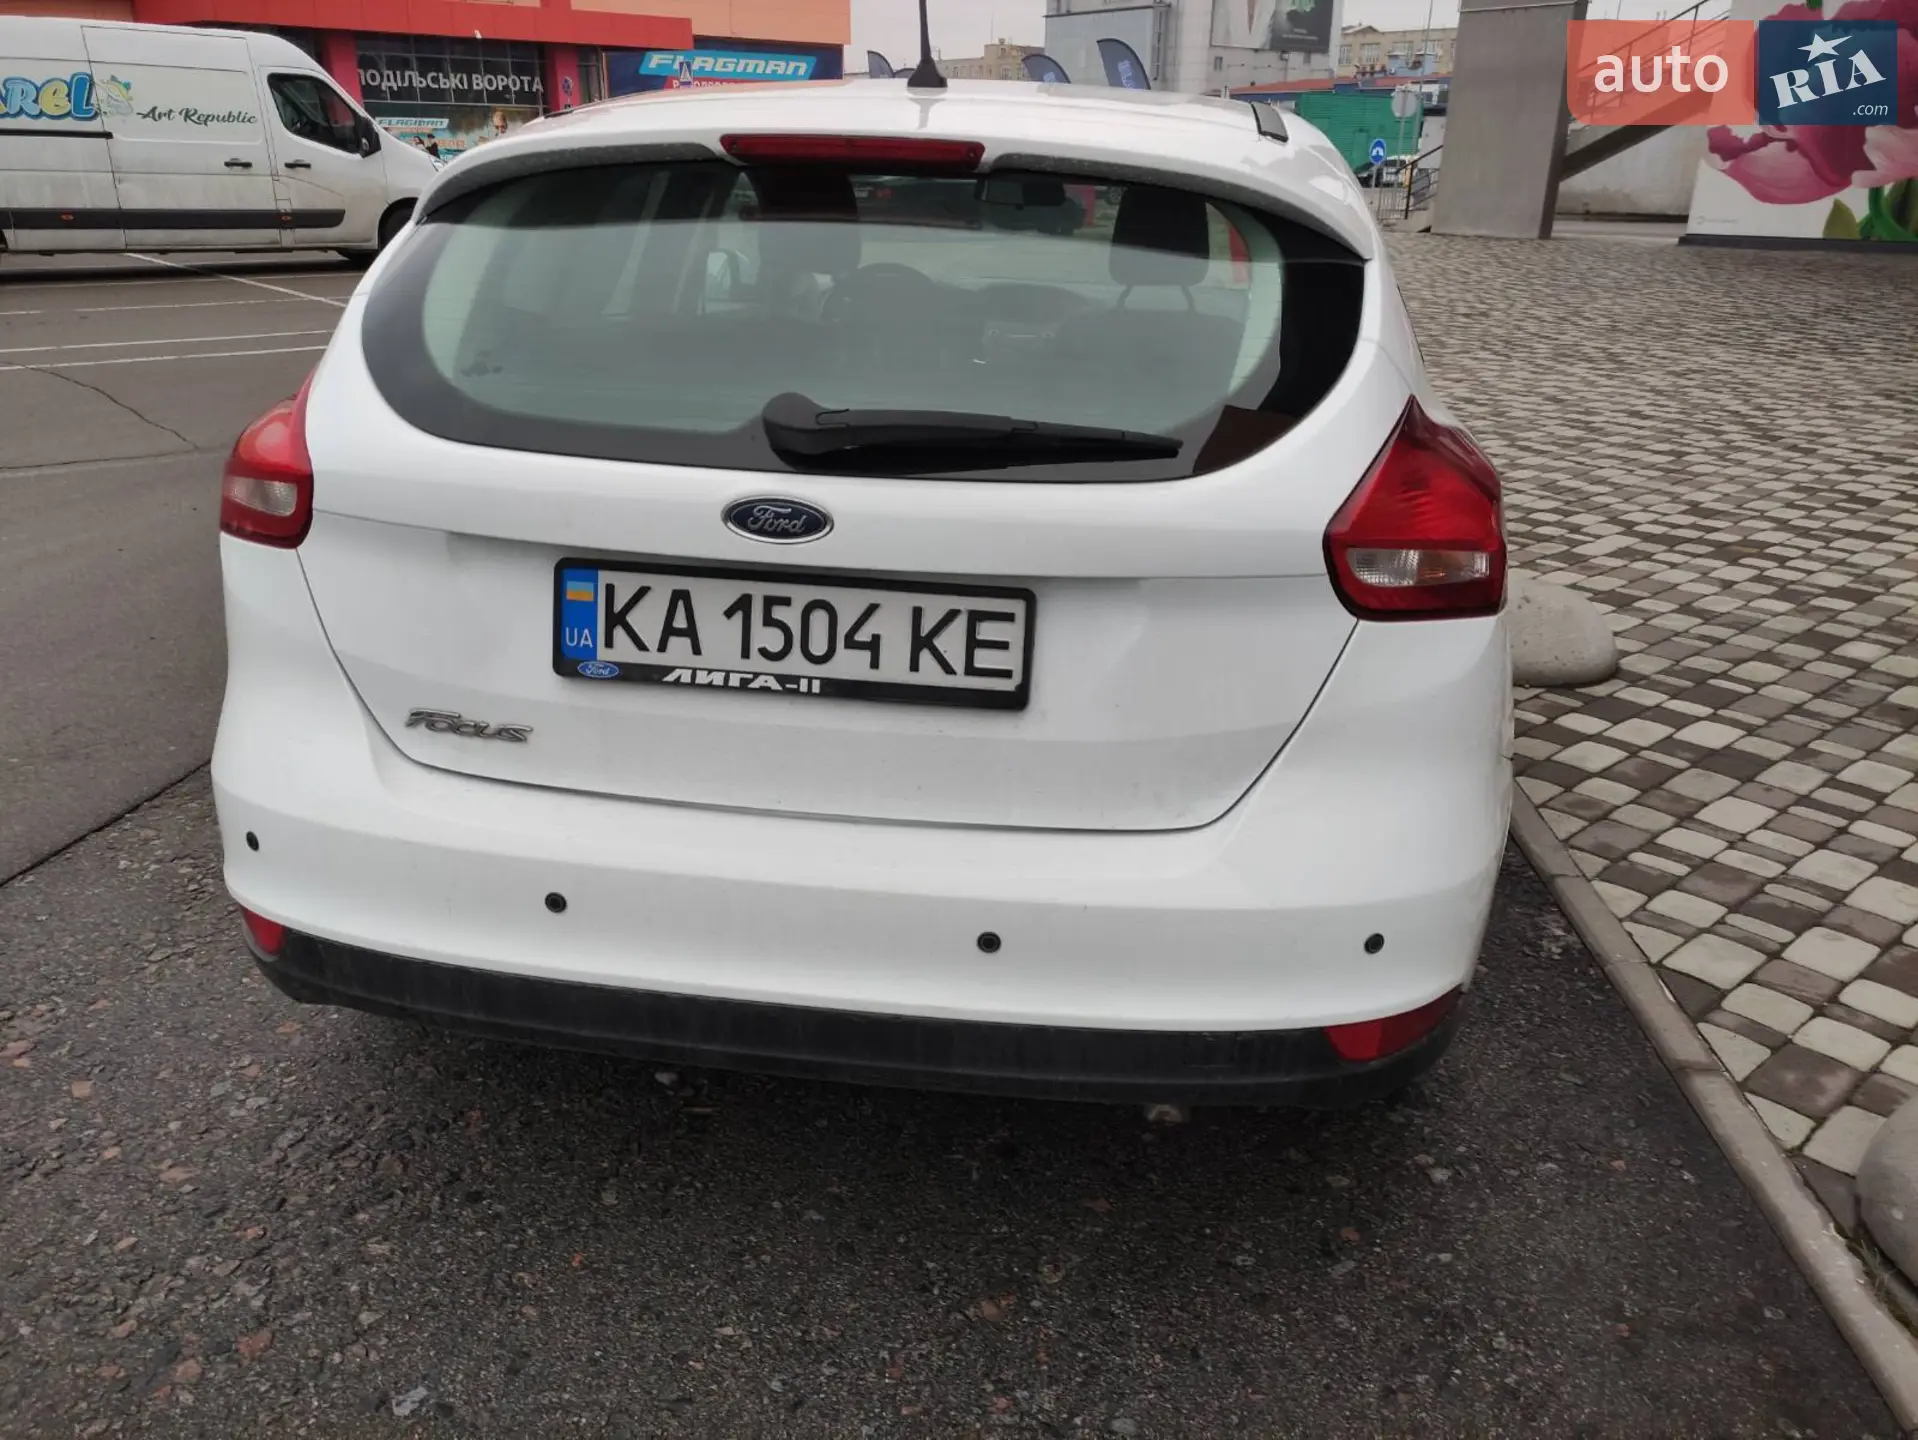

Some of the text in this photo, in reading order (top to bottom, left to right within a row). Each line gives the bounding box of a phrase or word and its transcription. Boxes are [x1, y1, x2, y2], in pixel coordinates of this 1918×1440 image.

[648, 53, 808, 76] FLAGMAN
[472, 74, 544, 93] ВОРОТА
[136, 106, 257, 127] Art Republic
[748, 505, 808, 532] Ford
[565, 627, 593, 648] UA
[604, 583, 1016, 679] KA 1504 KE
